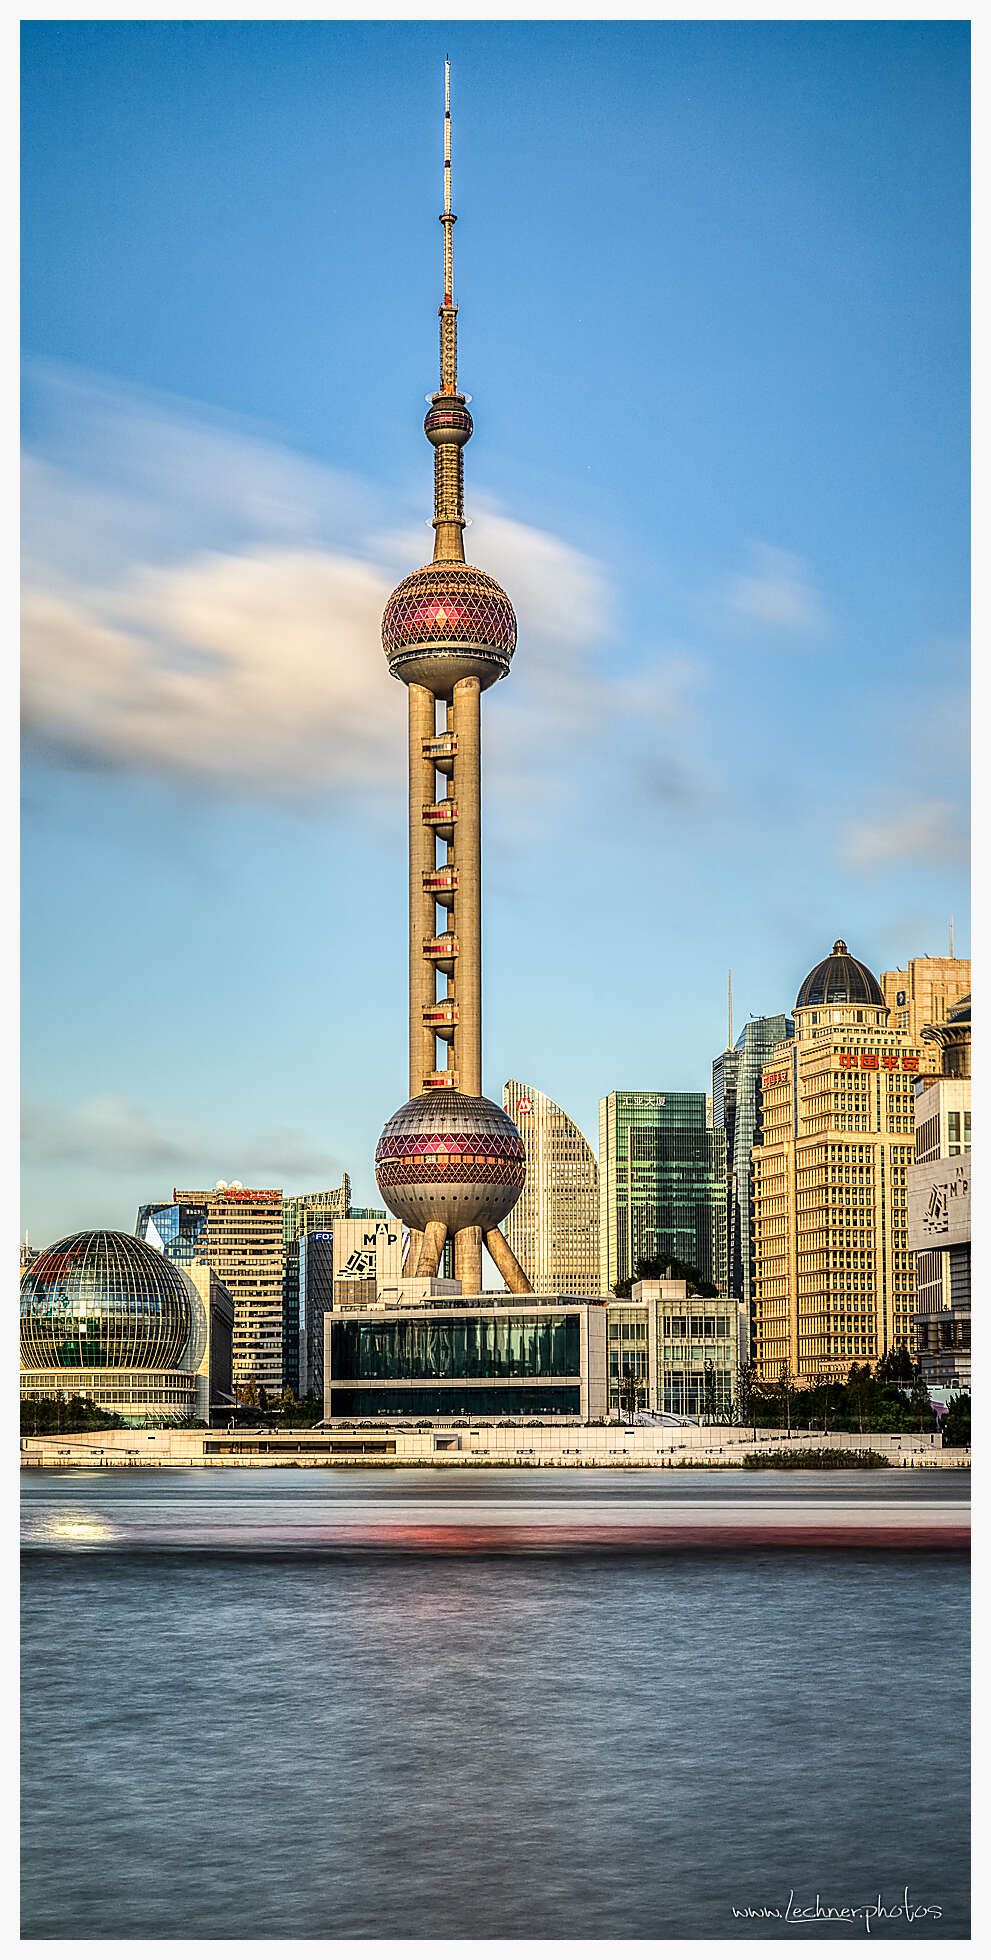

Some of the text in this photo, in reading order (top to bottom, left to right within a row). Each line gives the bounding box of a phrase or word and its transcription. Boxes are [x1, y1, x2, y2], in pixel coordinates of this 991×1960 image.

[839, 1052, 920, 1071] 中国平安
[623, 1096, 667, 1107] 汇亚大厦
